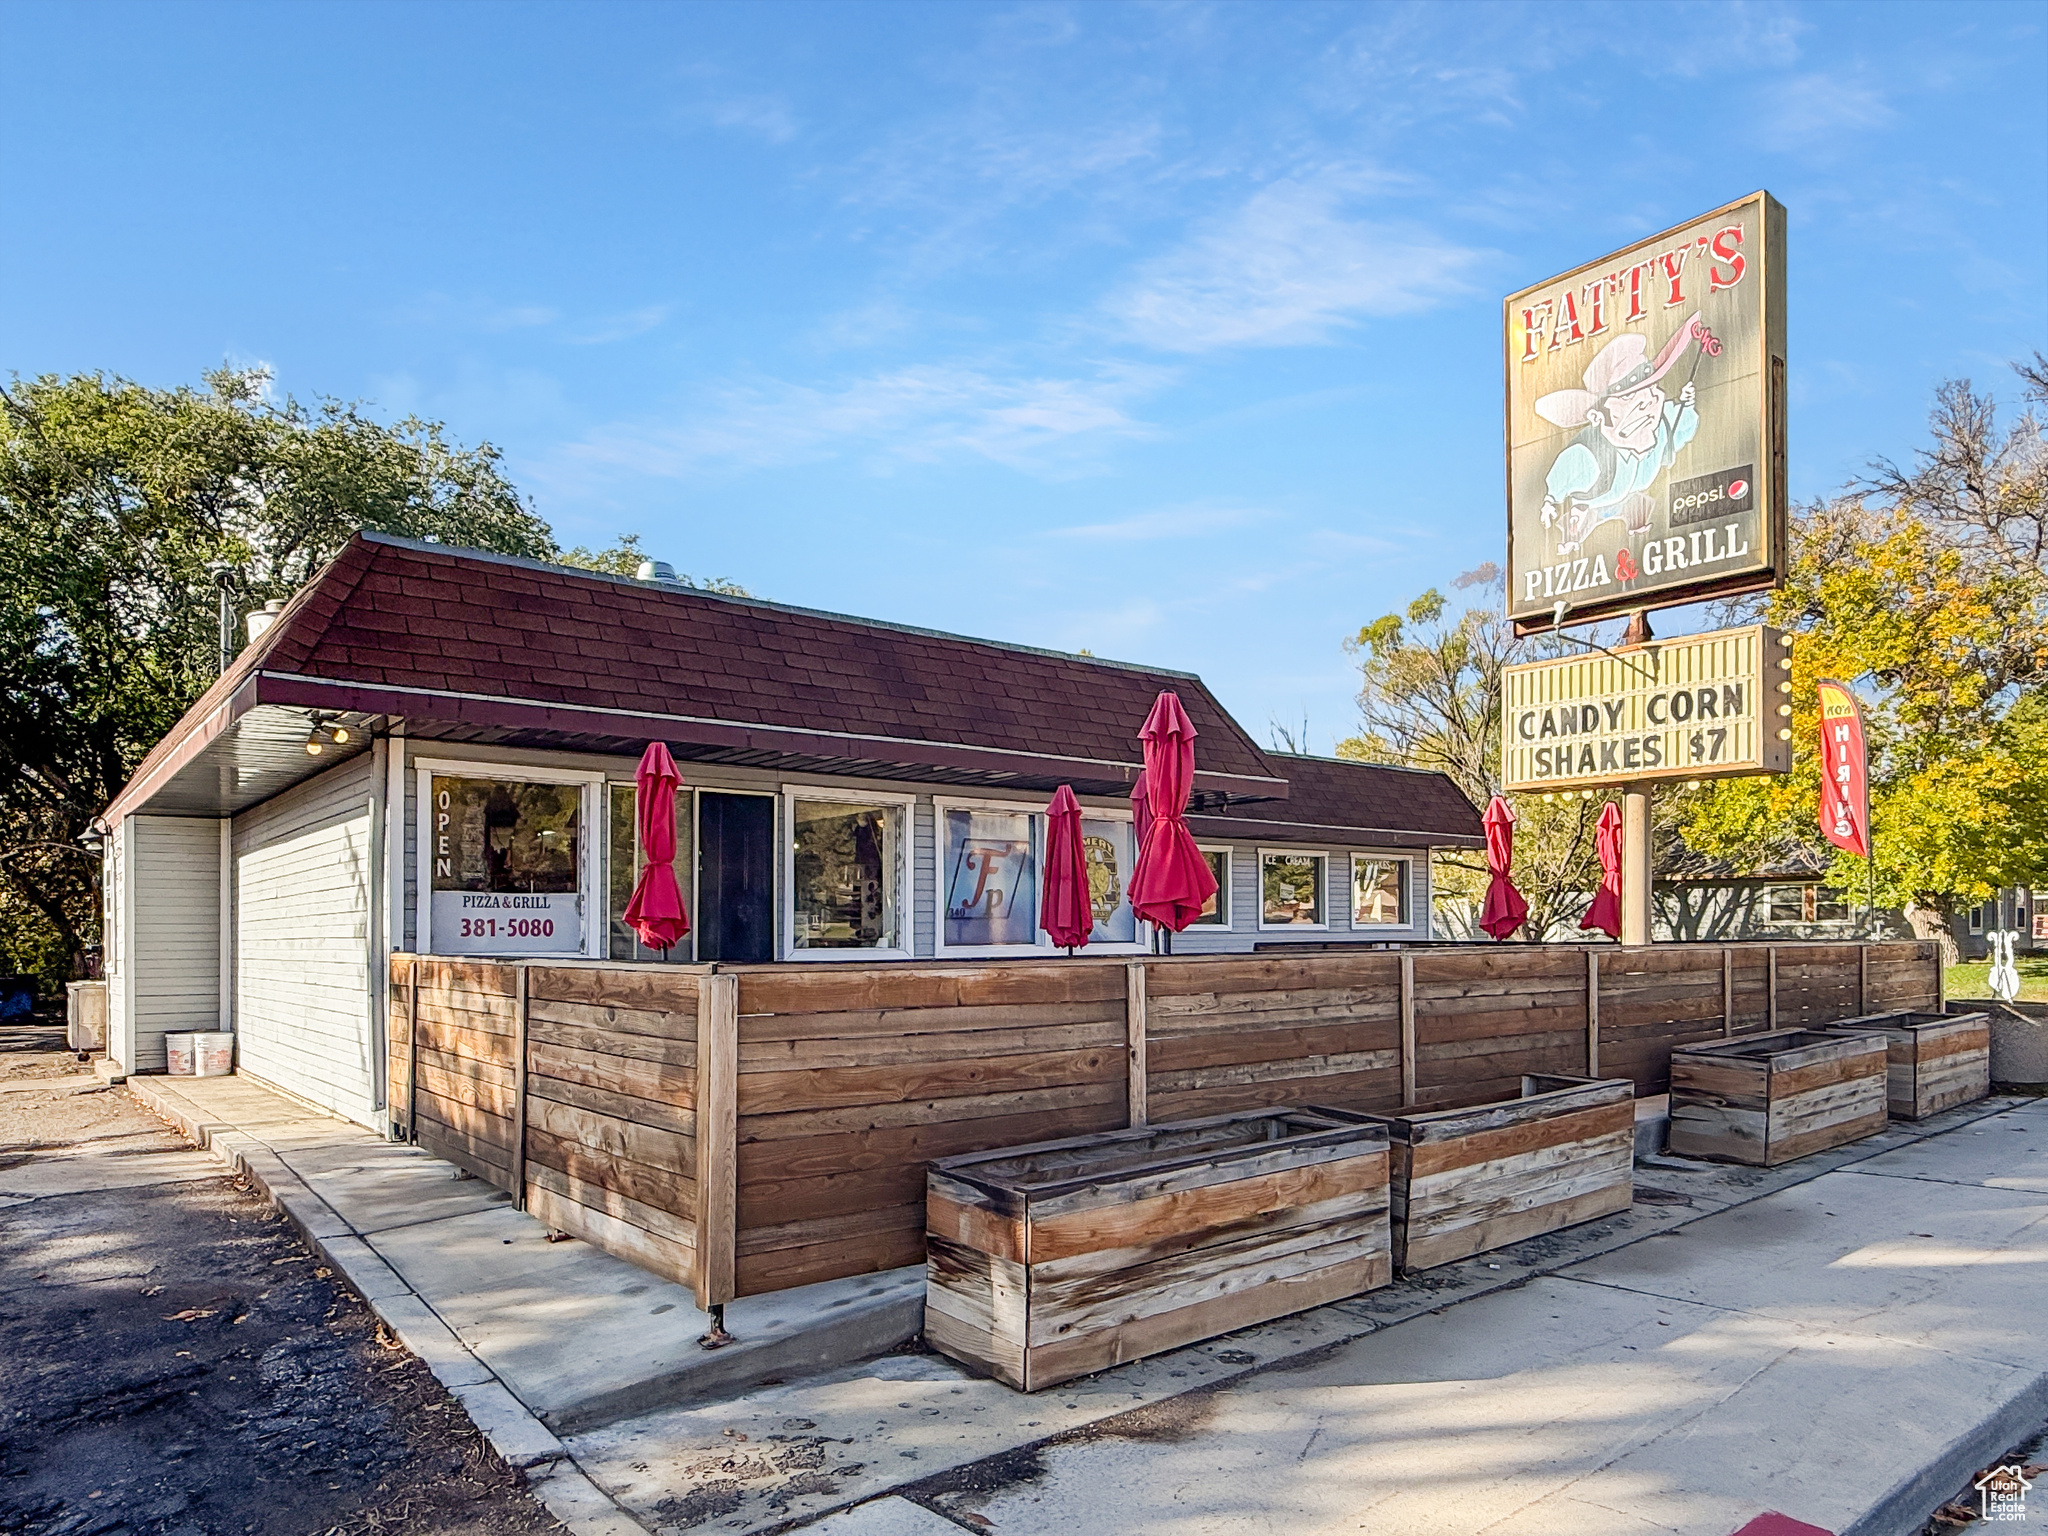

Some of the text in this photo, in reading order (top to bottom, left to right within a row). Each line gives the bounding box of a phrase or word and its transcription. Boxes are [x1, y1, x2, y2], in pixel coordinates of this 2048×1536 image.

[1521, 222, 1747, 362] FATTY'S
[1673, 484, 1725, 514] pepsi
[1524, 523, 1748, 601] PIZZA & GRILL
[1519, 683, 1744, 741] CANDY CORN
[1535, 728, 1728, 778] SHAKES $7
[436, 790, 451, 877] OPEN
[1082, 836, 1115, 855] MERY
[462, 895, 500, 909] PIZZA
[514, 896, 551, 909] GRILL
[460, 918, 554, 938] 381-5080
